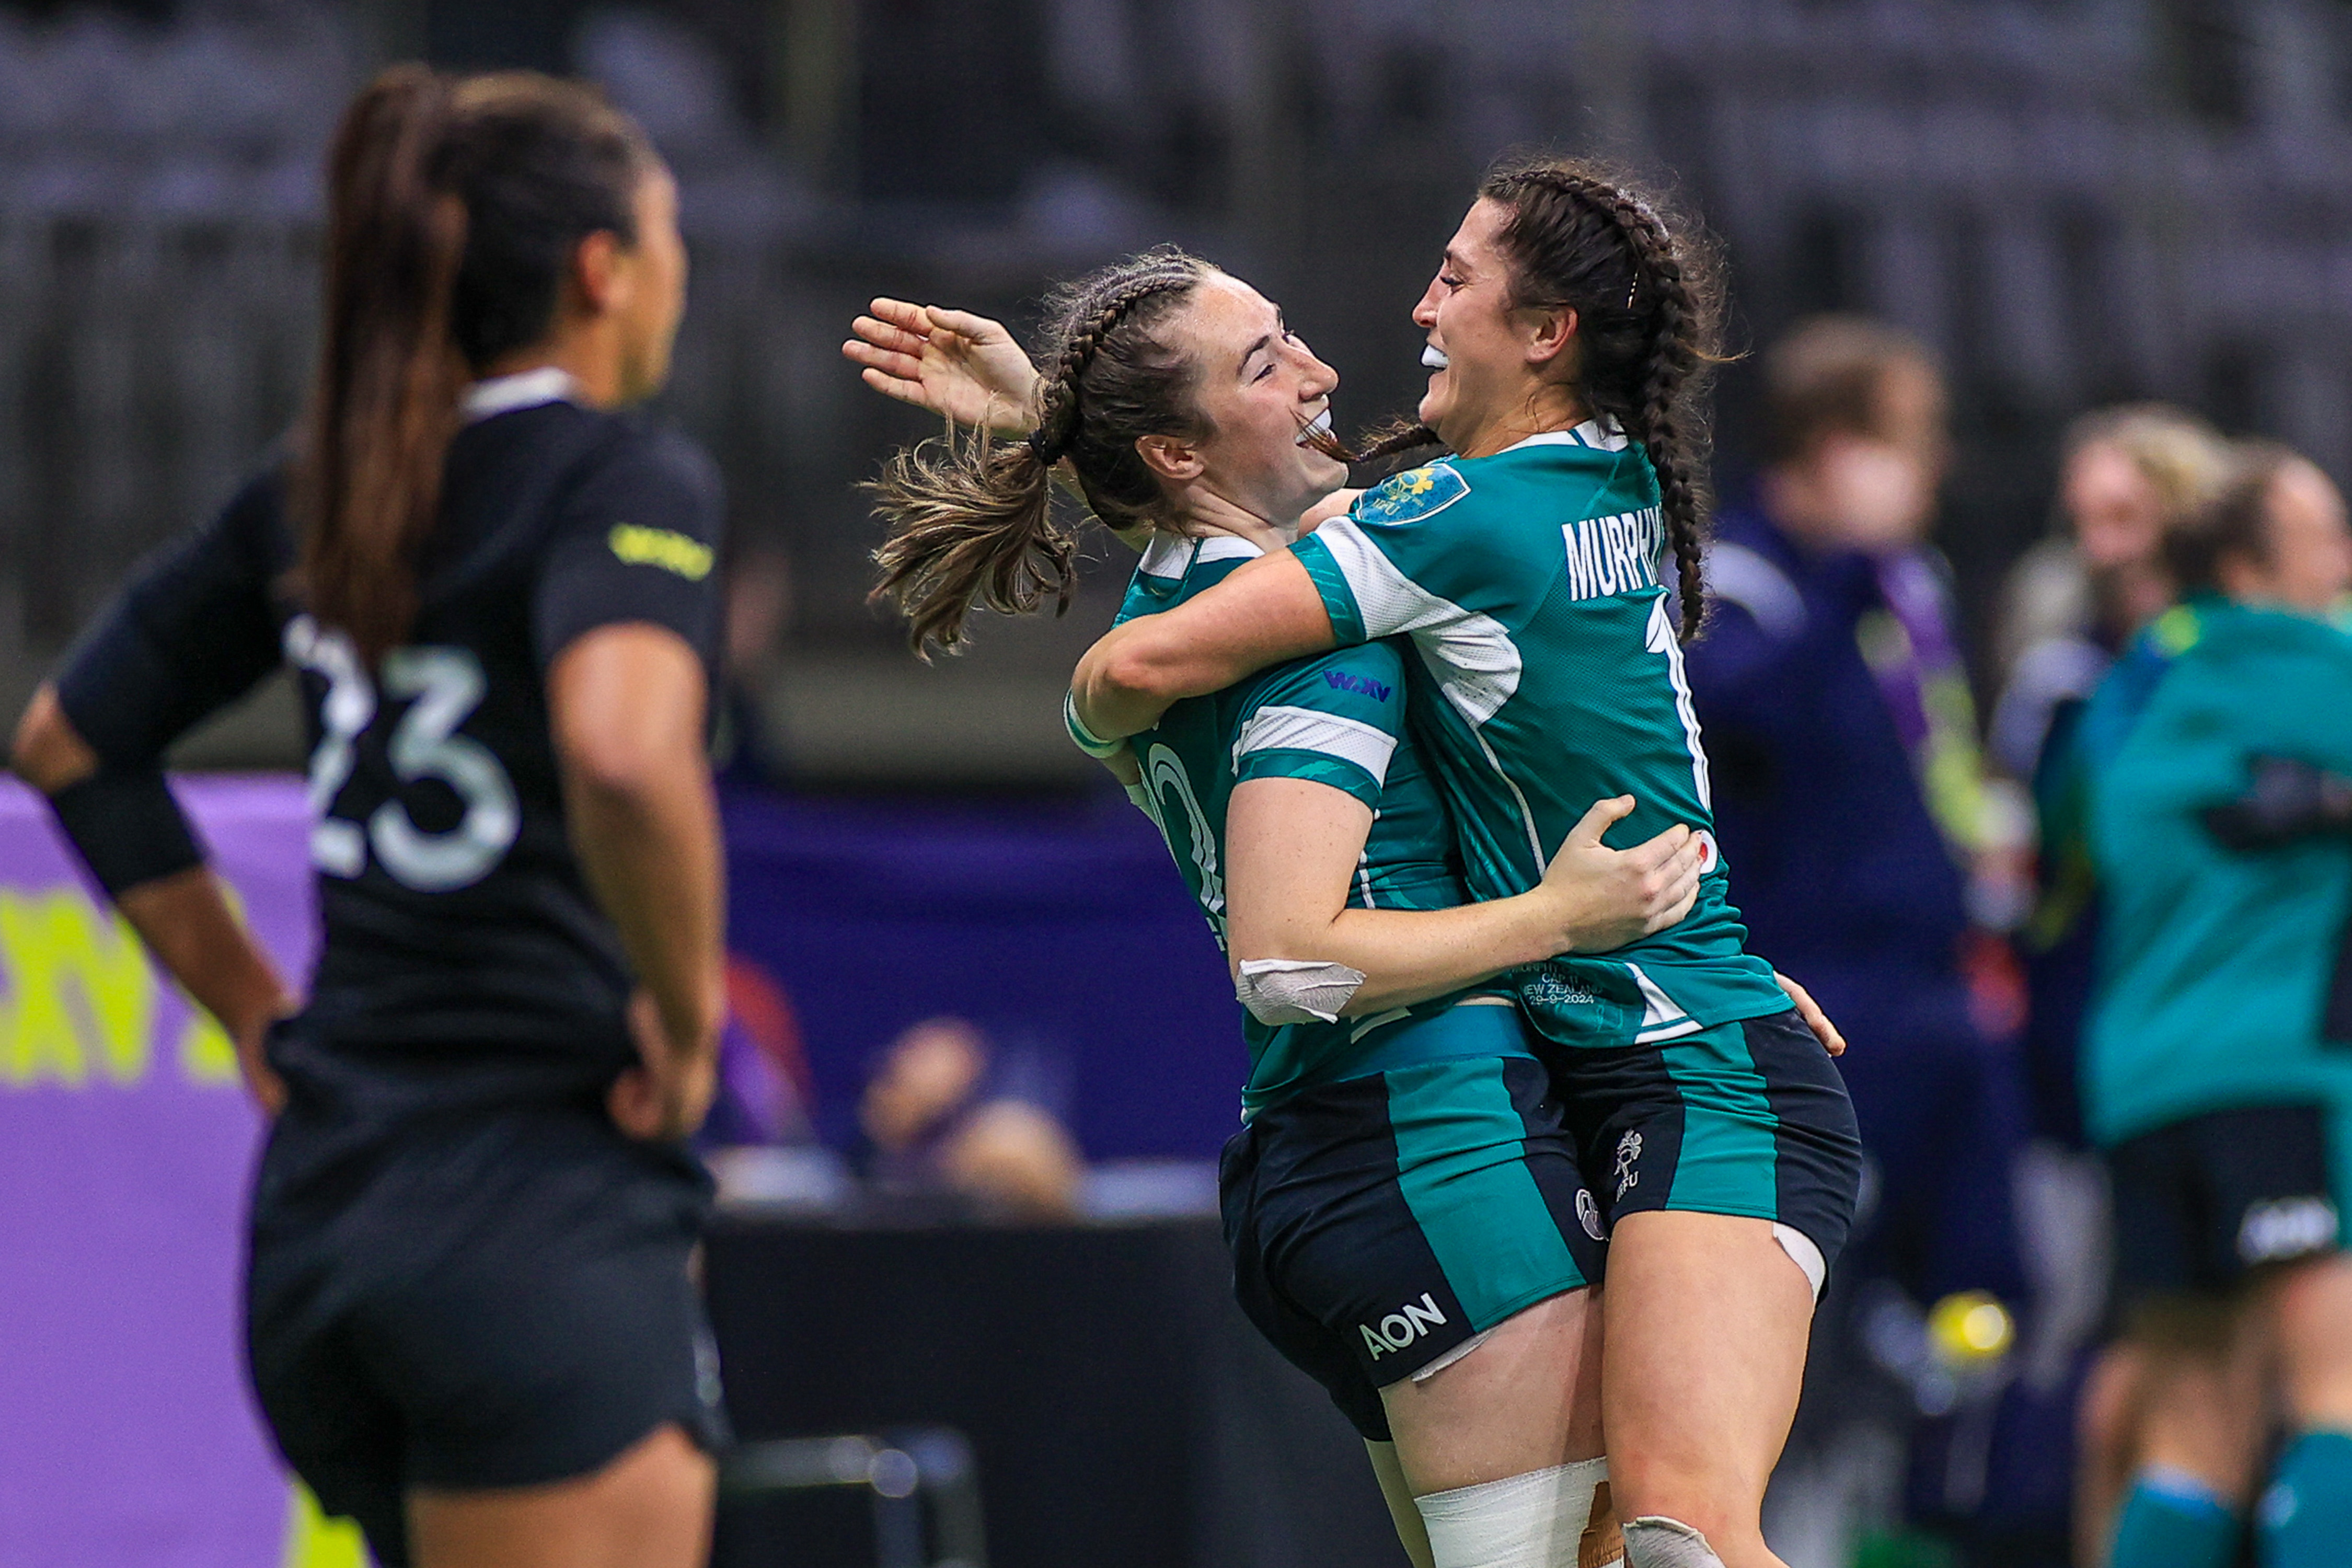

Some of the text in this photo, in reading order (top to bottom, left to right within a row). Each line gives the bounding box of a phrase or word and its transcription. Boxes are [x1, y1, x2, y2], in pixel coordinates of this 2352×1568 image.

[1561, 502, 1665, 601] MURPHY
[1529, 993, 1595, 1006] 29-9-2024
[1358, 1292, 1448, 1361] AON
